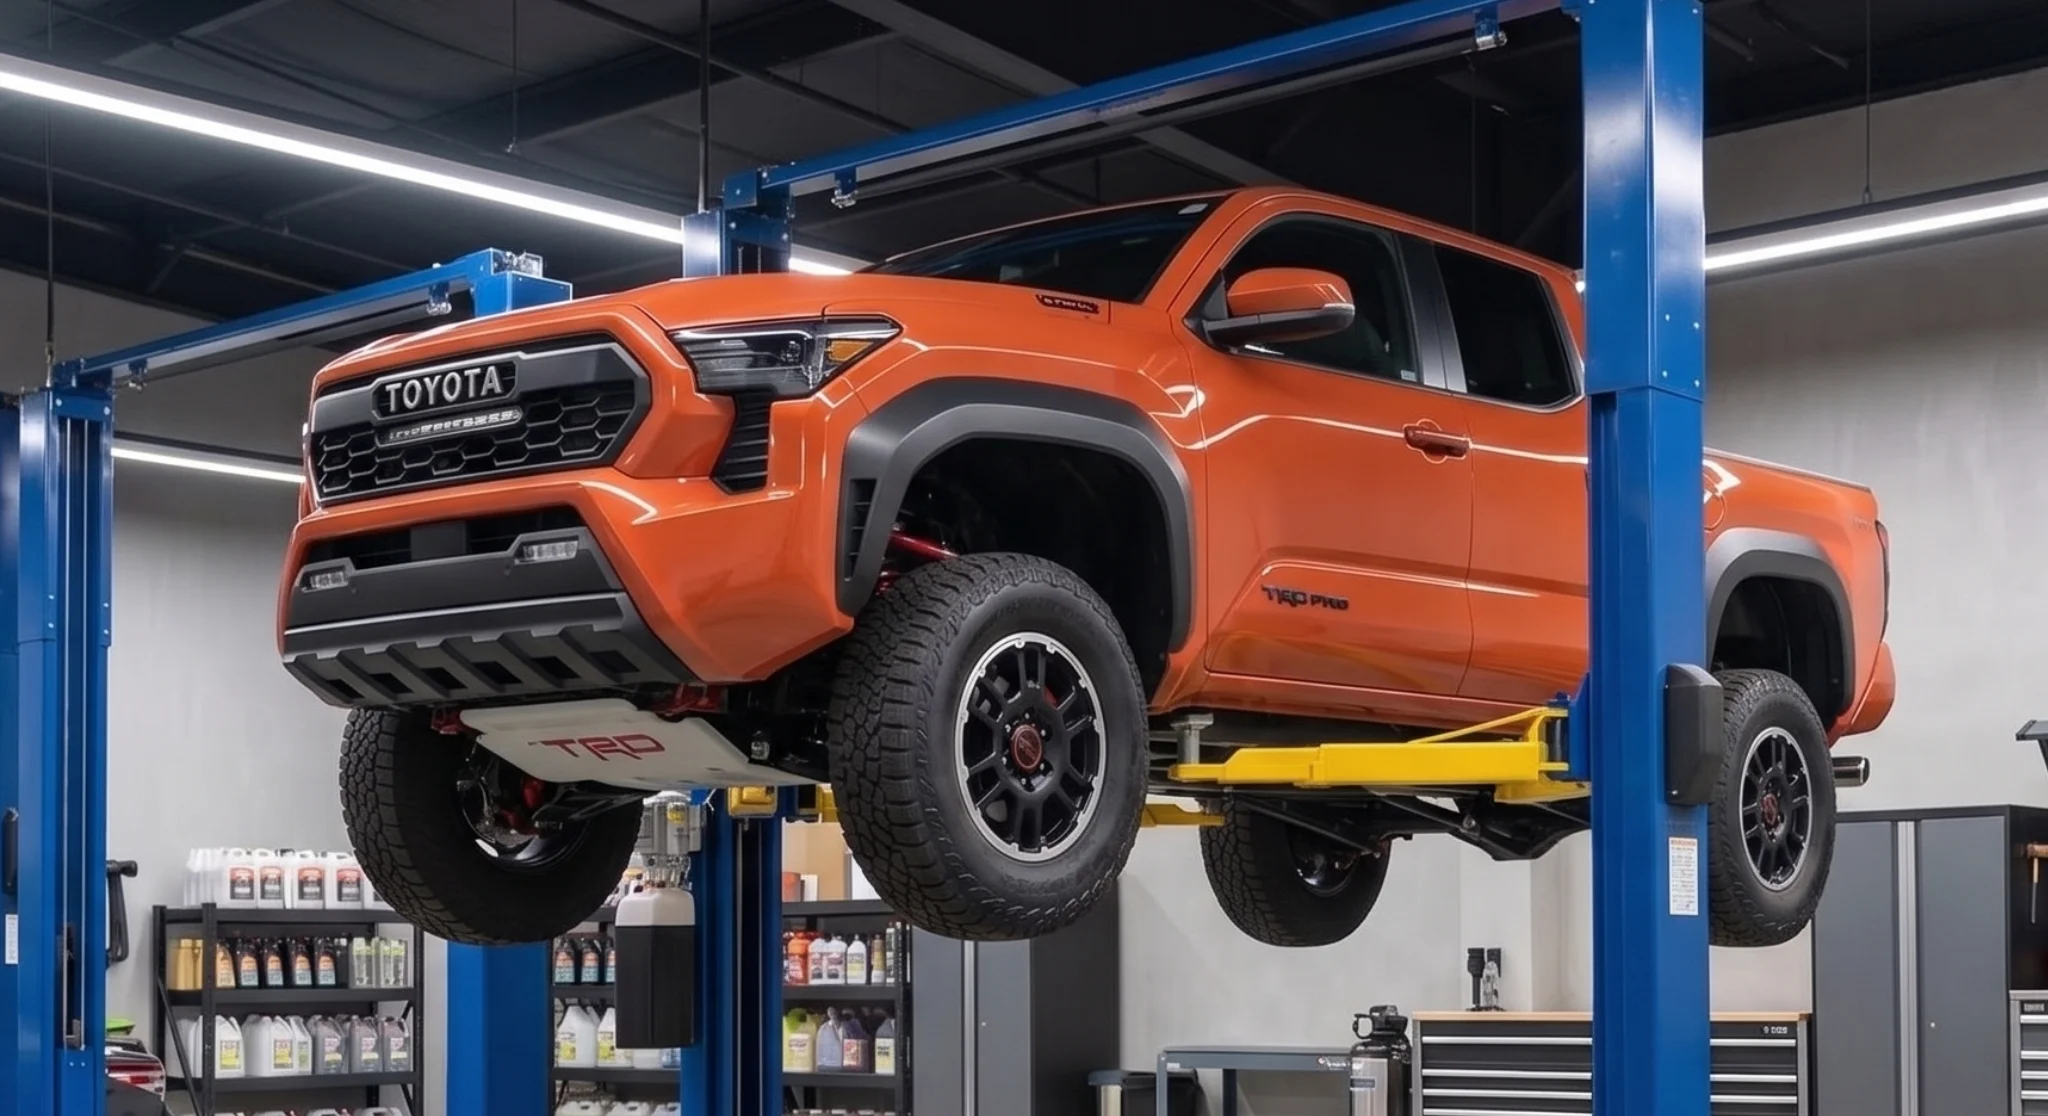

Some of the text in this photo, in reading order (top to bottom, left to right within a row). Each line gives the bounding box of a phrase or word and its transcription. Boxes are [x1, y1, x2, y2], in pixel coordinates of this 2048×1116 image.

[385, 365, 502, 413] TOYOTA
[1261, 585, 1307, 608] TRD
[528, 733, 666, 762] TRD
